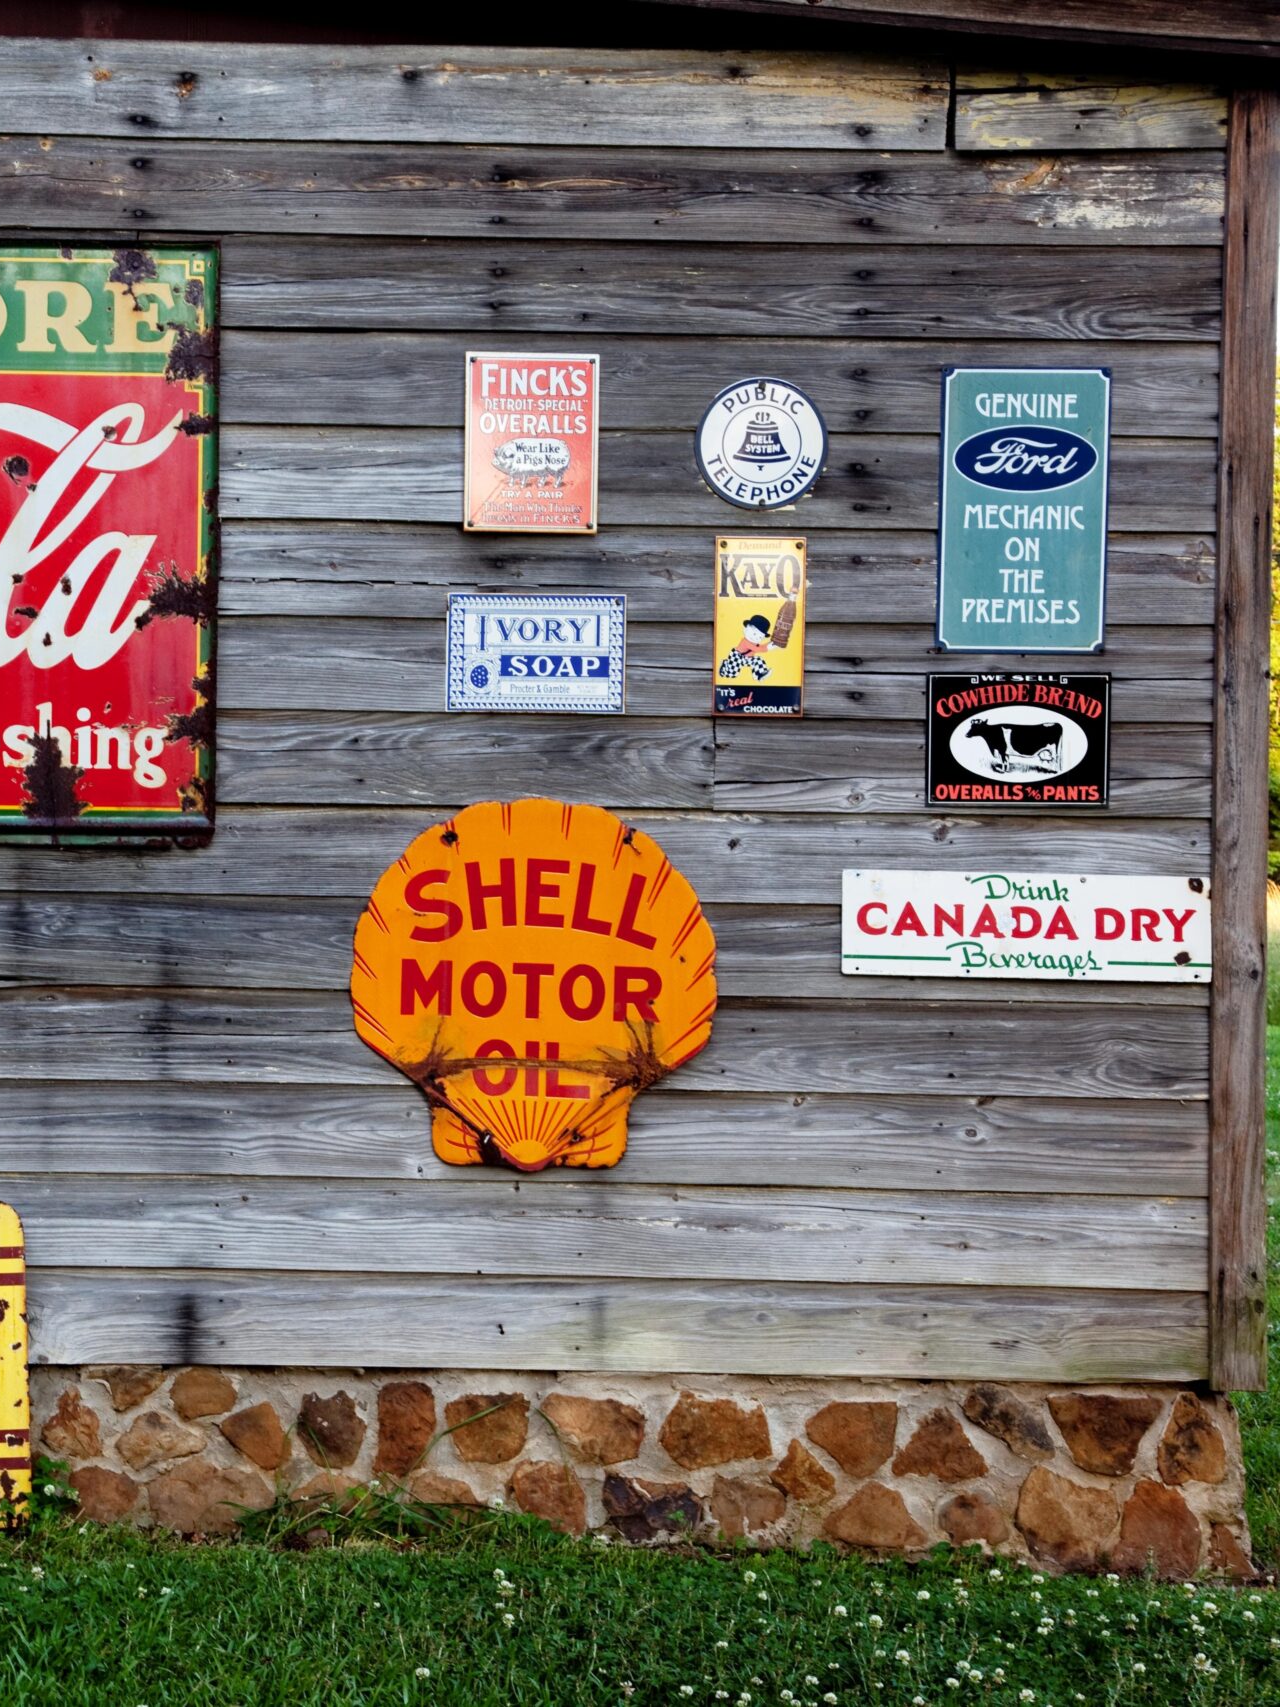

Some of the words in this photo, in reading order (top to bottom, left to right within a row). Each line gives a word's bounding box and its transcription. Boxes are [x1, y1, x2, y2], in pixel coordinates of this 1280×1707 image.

[482, 363, 587, 397] FINCK'S
[722, 387, 804, 415] PUBLIC
[975, 393, 1078, 418] GENUINE
[480, 413, 587, 436] OVERALLS
[515, 442, 538, 453] Wear
[539, 442, 561, 453] Like
[745, 444, 781, 454] SYSTEM
[750, 435, 774, 444] BELL
[974, 437, 1078, 474] Ford
[707, 454, 816, 501] TELEPHONE
[501, 490, 520, 499] TRY
[538, 491, 563, 499] PAIR
[963, 504, 1085, 529] MECHANIC
[1004, 537, 1040, 562] ON
[719, 554, 801, 598] KAYO
[999, 569, 1044, 594] THE
[962, 599, 1080, 624] PREMISES
[477, 614, 590, 652] IVORY
[508, 656, 600, 677] SOAP
[510, 683, 535, 693] Procter
[536, 684, 541, 693] &
[543, 683, 570, 693] Gamble
[726, 691, 754, 708] real
[743, 705, 793, 714] CHOCOLATE
[936, 684, 1029, 718] COWHIDE
[1034, 684, 1102, 719] BRAND
[935, 784, 1024, 800] OVERALLS
[1025, 786, 1042, 801] AND
[1043, 786, 1100, 801] PANTS
[970, 874, 1069, 902] Drink
[404, 857, 657, 950] SHELL
[856, 900, 1079, 940] CANADA
[1094, 907, 1197, 943] DRY
[946, 941, 1103, 977] Beverages
[400, 958, 663, 1023] MOTOR
[472, 1039, 590, 1100] OIL
